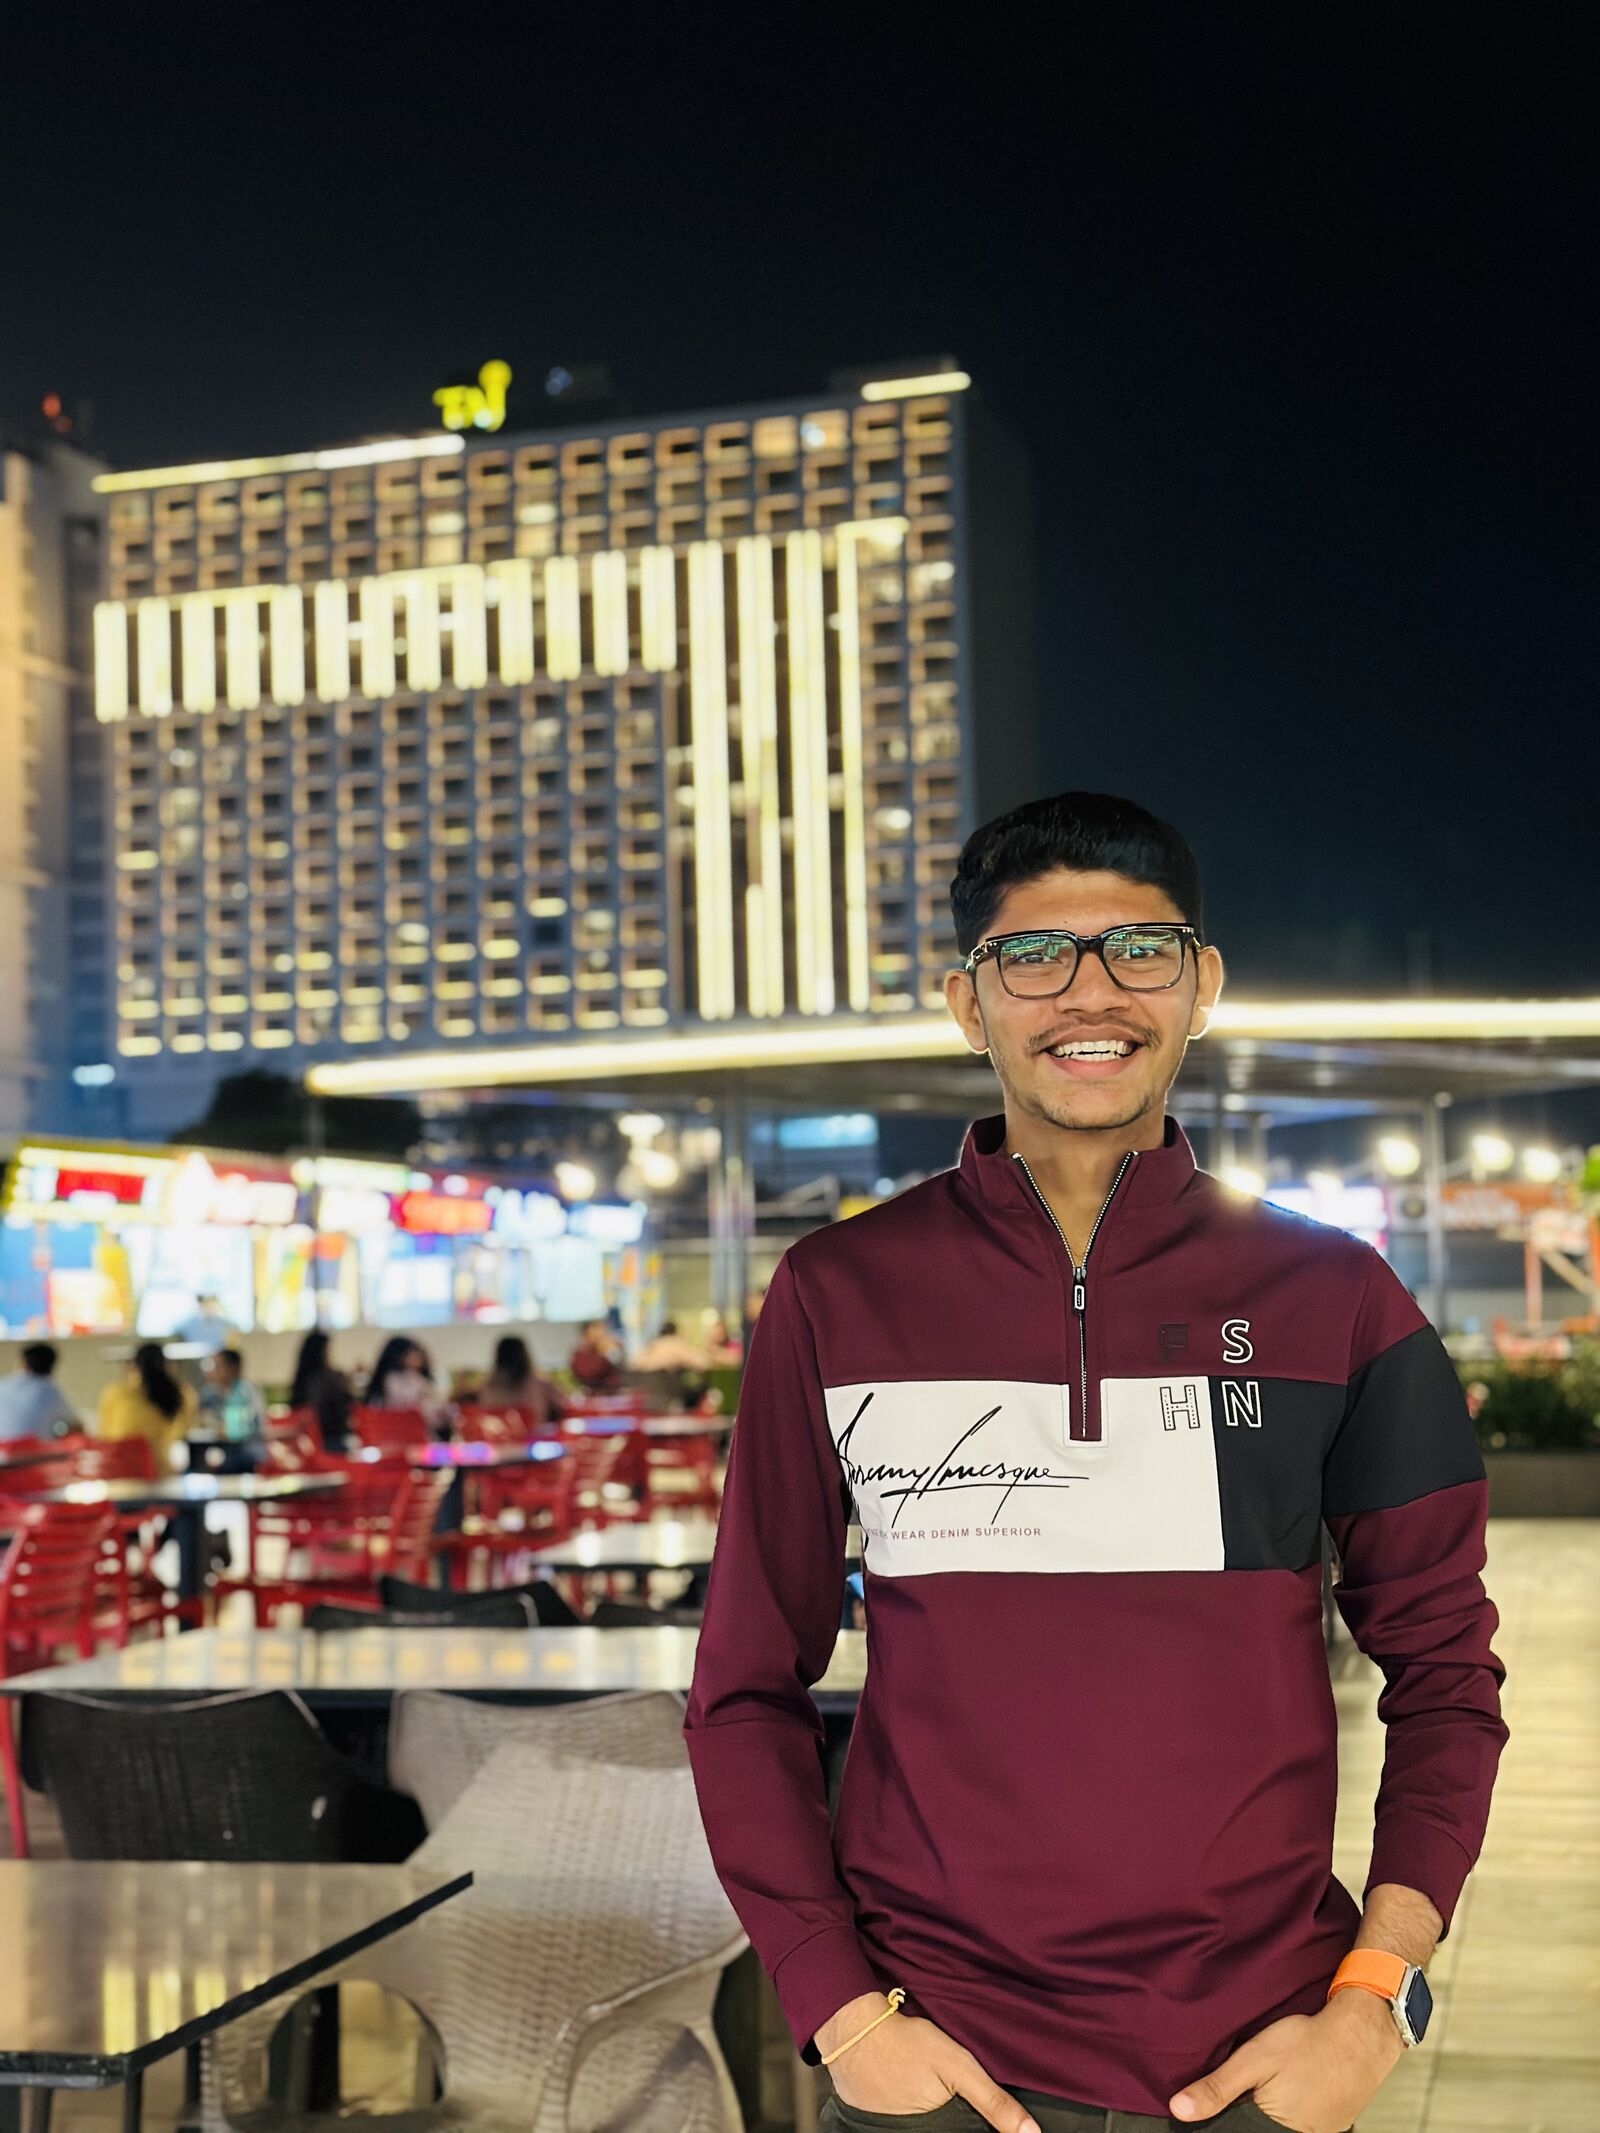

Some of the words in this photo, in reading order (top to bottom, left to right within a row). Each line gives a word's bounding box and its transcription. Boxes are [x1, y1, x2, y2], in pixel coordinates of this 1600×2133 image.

[1221, 1319, 1253, 1363] S
[1160, 1384, 1200, 1430] H
[1221, 1380, 1262, 1427] N
[891, 1531, 926, 1540] WEAR
[931, 1528, 970, 1539] DENIM
[975, 1527, 1042, 1537] SUPERIOR
